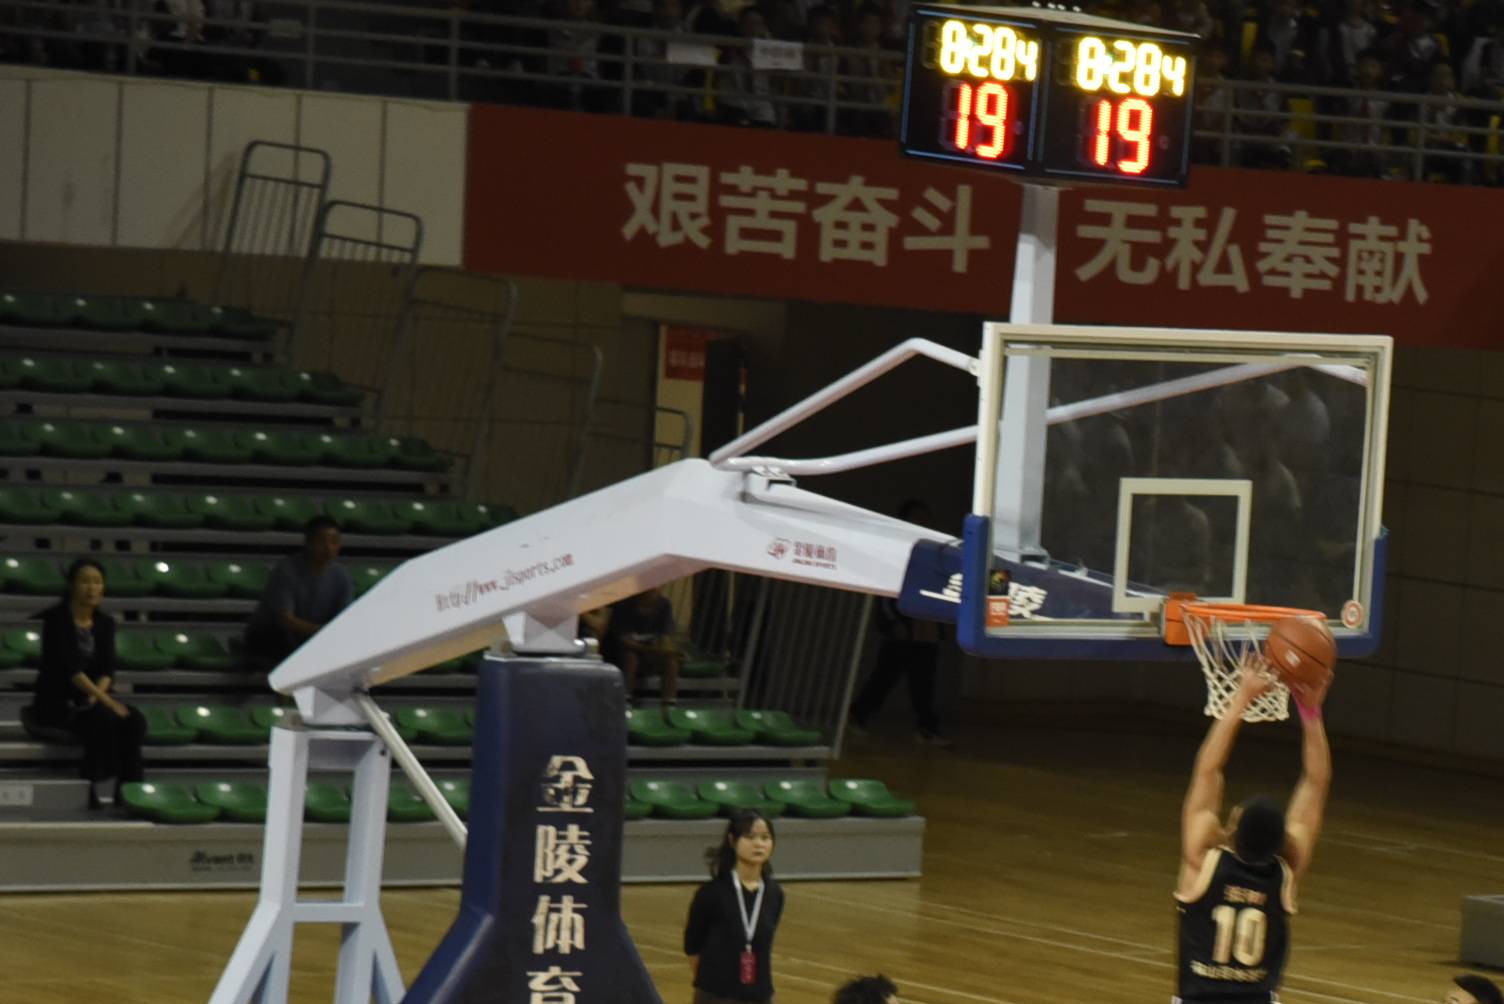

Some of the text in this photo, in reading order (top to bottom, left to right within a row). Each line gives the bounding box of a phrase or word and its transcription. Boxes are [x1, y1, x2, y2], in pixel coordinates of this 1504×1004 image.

[955, 82, 1009, 158] 19
[1094, 97, 1153, 174] 19
[621, 162, 1434, 305] 艰苦奋斗 无私奉献
[1211, 904, 1267, 967] 10
